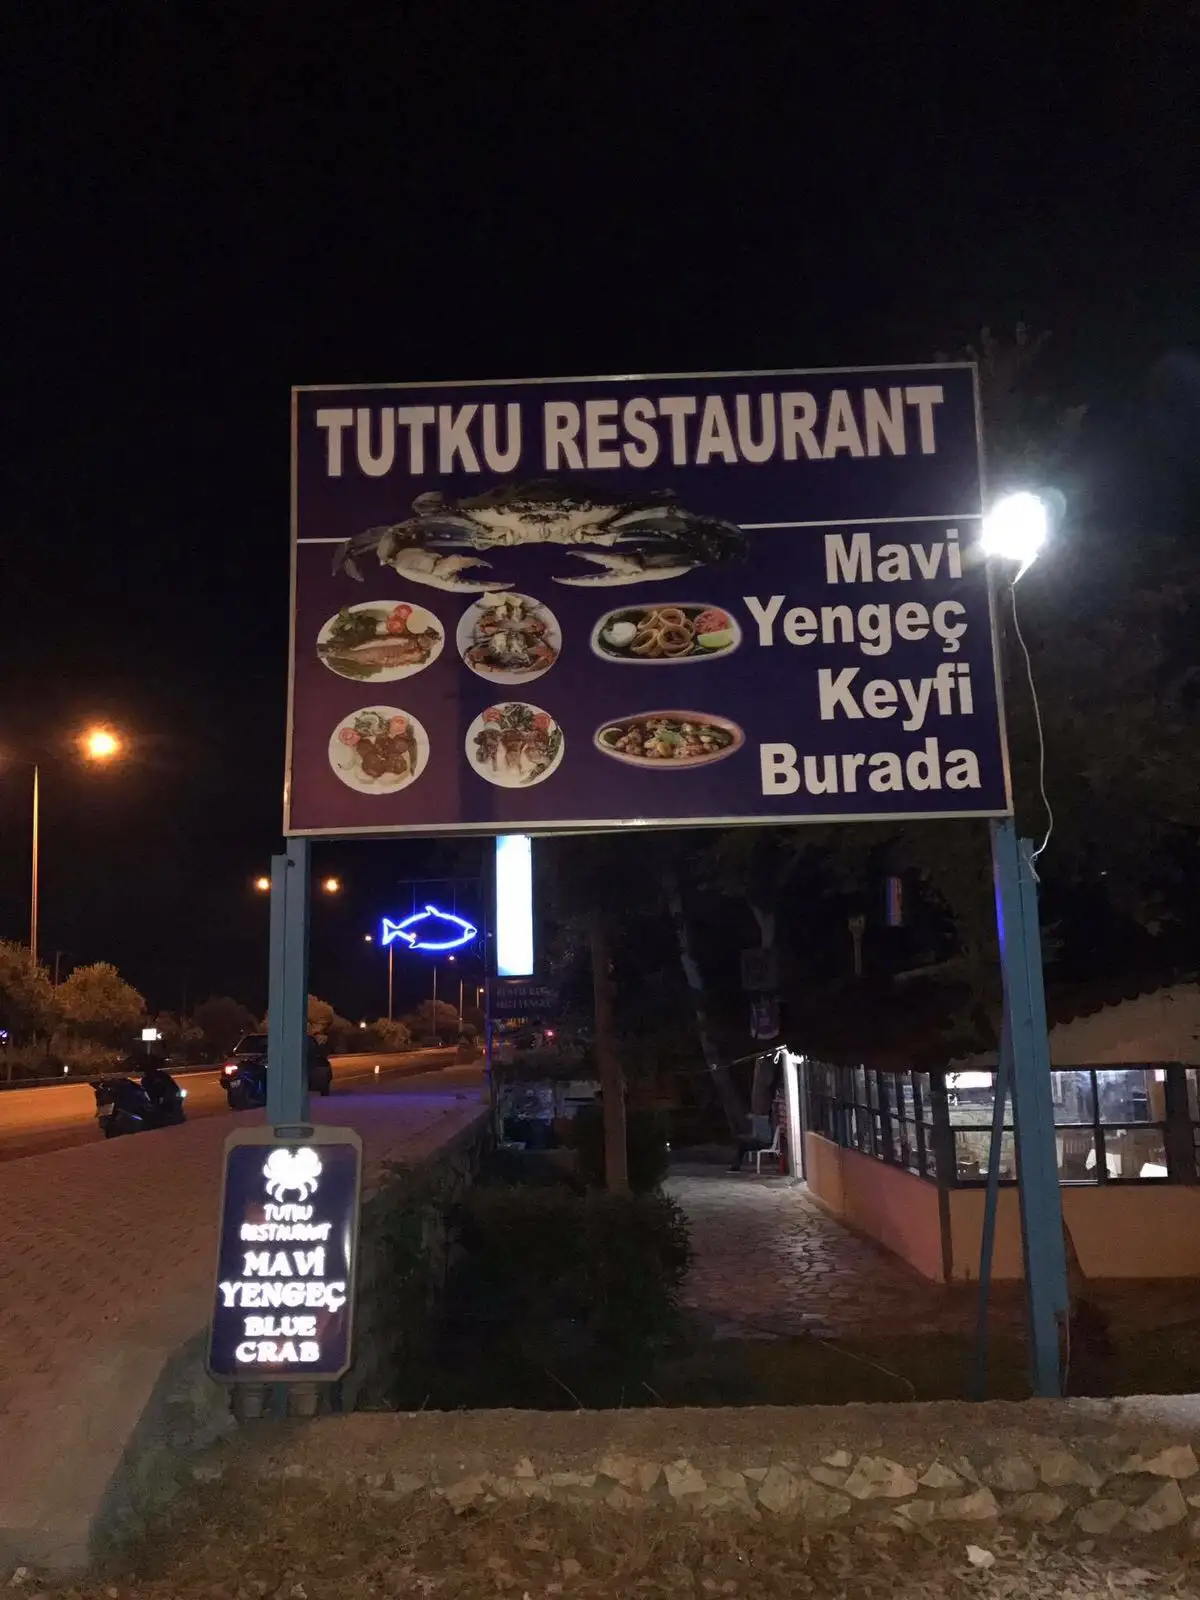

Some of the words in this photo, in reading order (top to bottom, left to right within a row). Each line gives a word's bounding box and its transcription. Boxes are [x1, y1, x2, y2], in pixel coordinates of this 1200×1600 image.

[315, 403, 522, 477] TUTKU
[543, 383, 944, 471] RESTAURANT
[823, 528, 963, 585] Mavi
[743, 595, 968, 654] Yengeç
[818, 662, 974, 731] Keyfi
[760, 736, 981, 796] Burada
[243, 1246, 326, 1277] MAVİ
[219, 1281, 346, 1313] YENGEÇ
[235, 1340, 320, 1363] CRAB
[243, 1315, 317, 1337] BLUE
